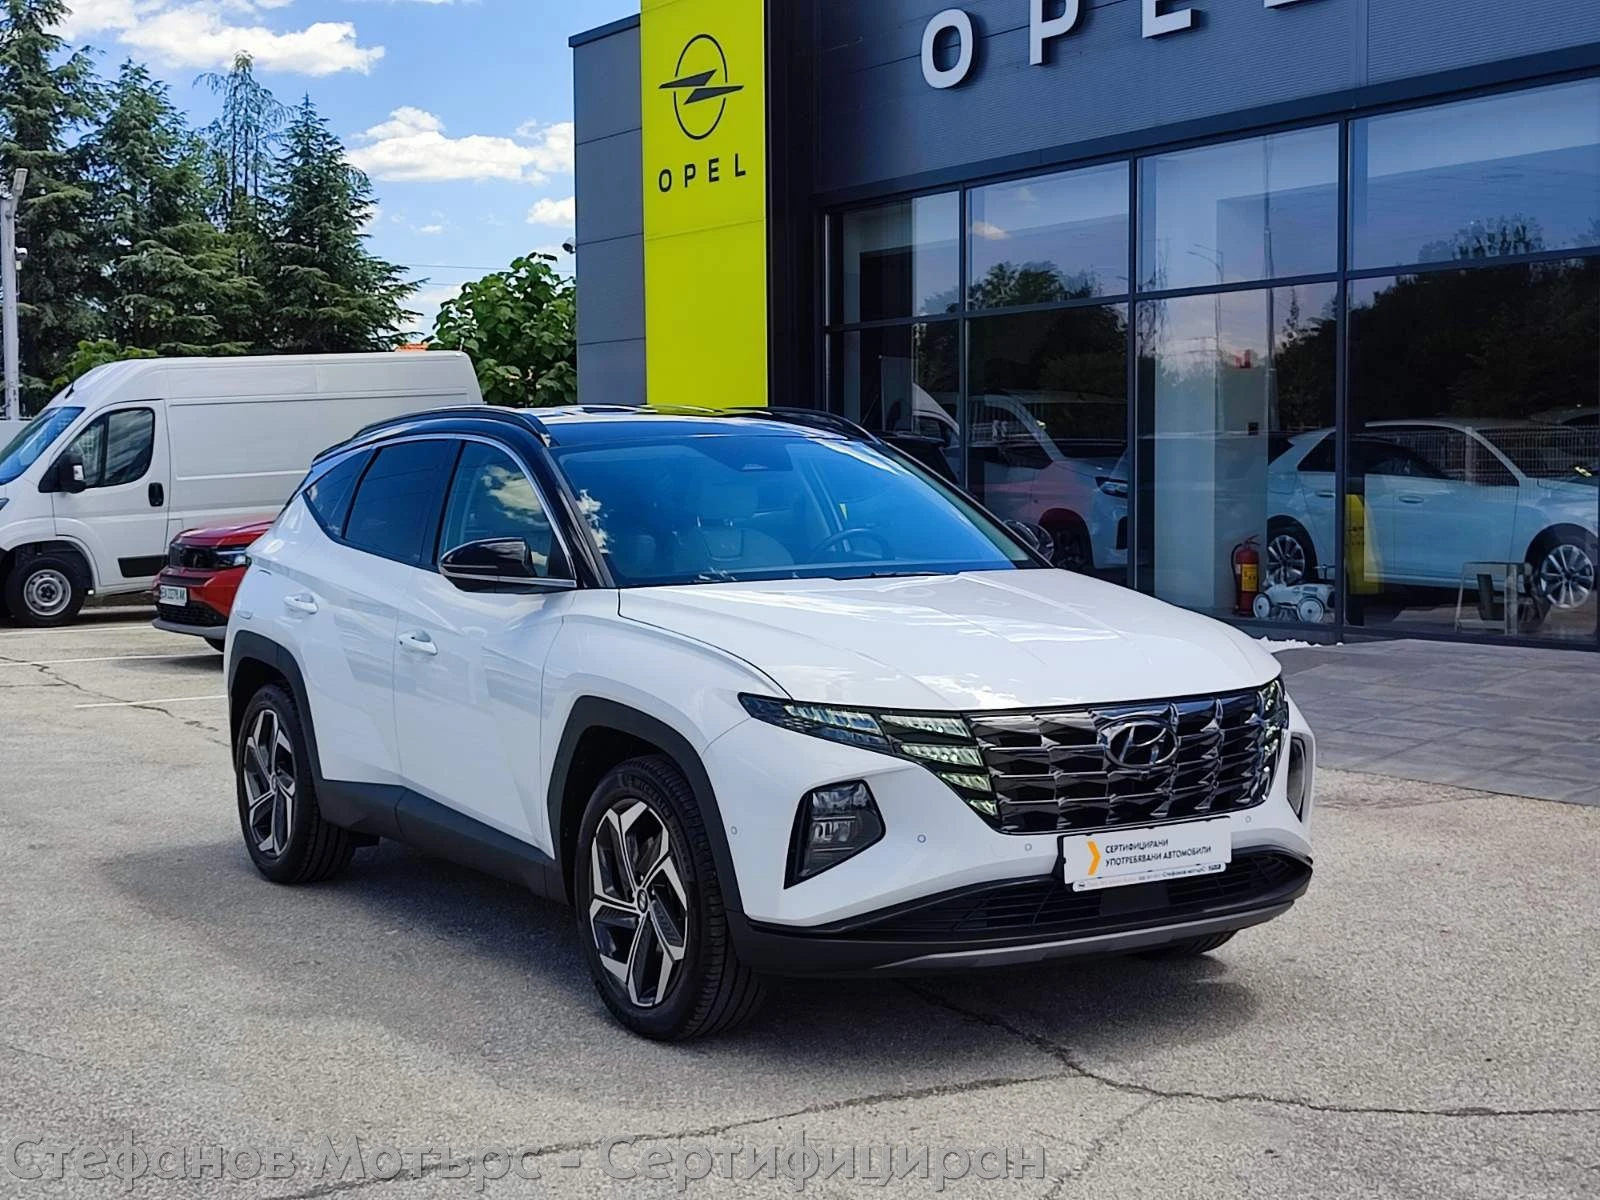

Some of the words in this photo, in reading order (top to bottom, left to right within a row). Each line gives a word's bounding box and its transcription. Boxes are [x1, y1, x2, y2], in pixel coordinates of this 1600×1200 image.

[658, 153, 746, 193] OPEL
[1105, 839, 1169, 854] СЕРТИФИЦИРАНИ
[1105, 853, 1162, 867] УПОТРЕБЯВАНИ
[1163, 846, 1212, 859] АВТОМОБИЛИ
